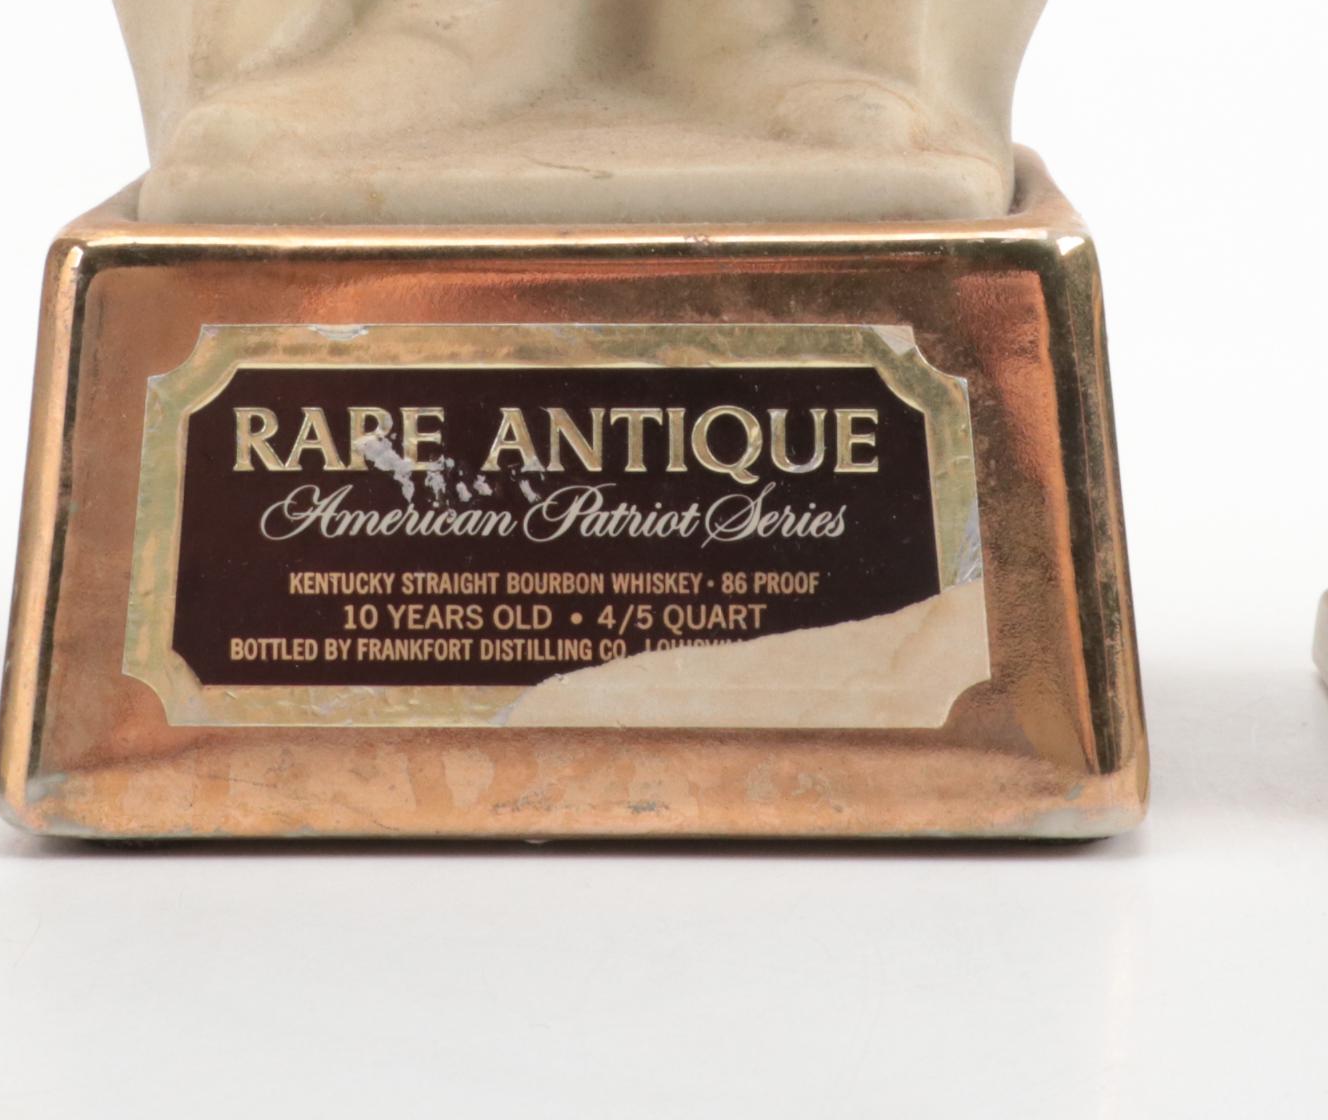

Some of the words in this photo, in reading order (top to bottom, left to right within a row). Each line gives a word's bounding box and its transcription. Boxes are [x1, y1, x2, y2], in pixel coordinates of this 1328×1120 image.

[480, 405, 879, 484] ANTIQUE
[260, 484, 518, 541] American
[522, 483, 701, 542] Patriot
[701, 481, 847, 548] Series
[289, 572, 396, 595] KENTUCKY
[401, 572, 499, 595] STRAIGHT
[506, 572, 604, 595] BOURBON
[611, 572, 703, 595] WHISKEY
[721, 572, 747, 594] 86
[754, 572, 820, 594] PROOF
[343, 604, 378, 630] 10
[387, 604, 484, 630] YEARS
[492, 604, 553, 630] OLD
[597, 604, 654, 635] 4/5
[663, 604, 767, 635] QUART
[230, 638, 318, 661] BOTTLED
[324, 638, 352, 661] BY
[357, 638, 473, 661] FRANKFORT
[480, 638, 592, 661] DISTILLING
